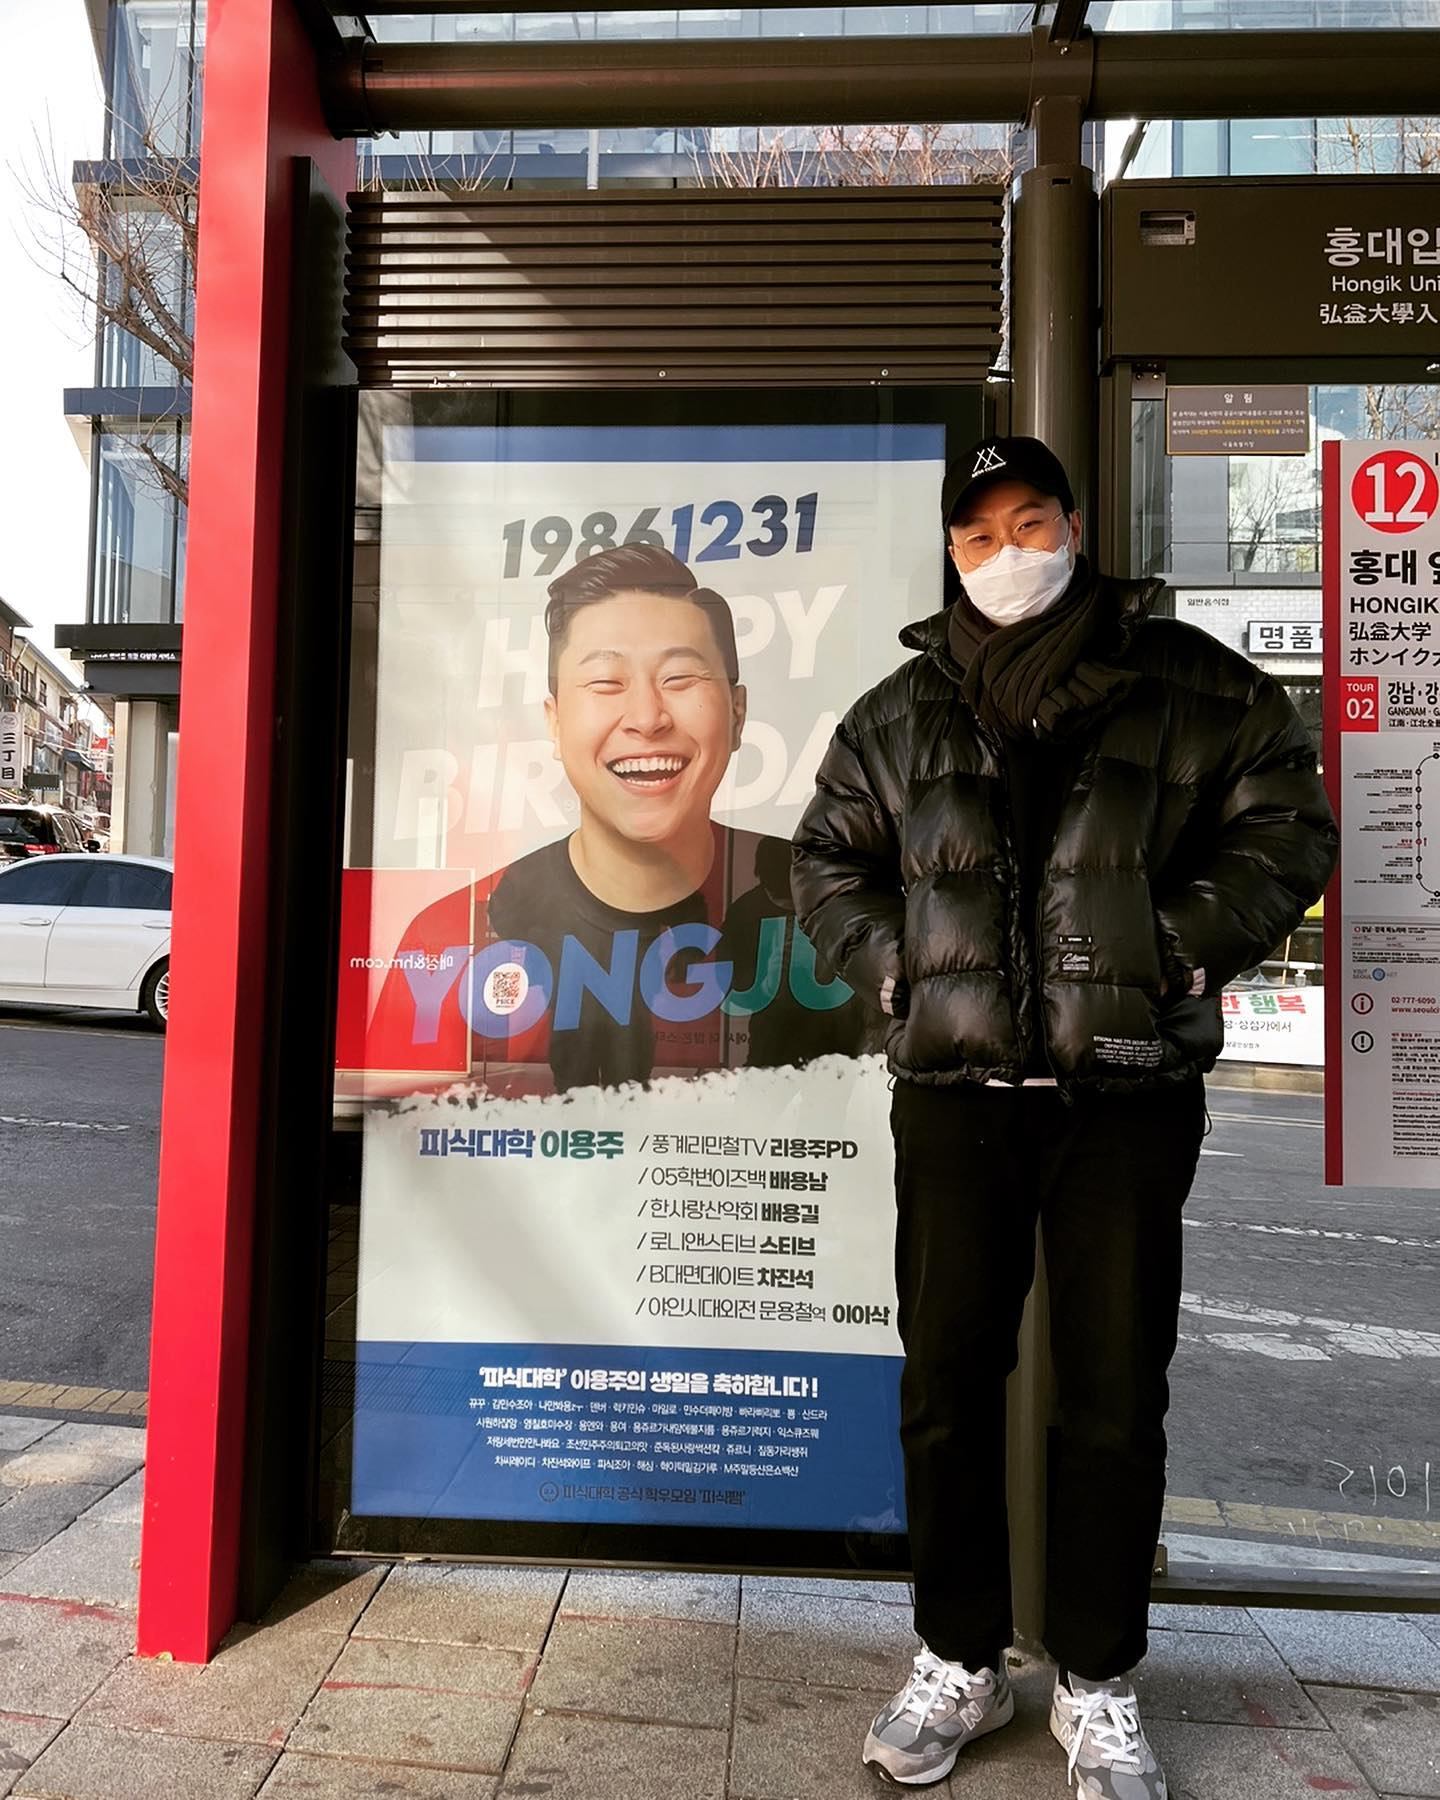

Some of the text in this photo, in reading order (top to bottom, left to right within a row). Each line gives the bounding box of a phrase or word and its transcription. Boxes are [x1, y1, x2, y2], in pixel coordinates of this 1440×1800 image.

[1331, 275, 1402, 295] Hongik
[1364, 461, 1429, 523] 12
[502, 491, 819, 579] 19861231
[1349, 550, 1417, 586] 홍대
[1349, 597, 1440, 614] HONGIK
[1349, 621, 1432, 641] 弘益大学
[1346, 682, 1375, 693] TOUR
[1346, 697, 1376, 721] 02
[1247, 993, 1307, 1015] 행복
[419, 1128, 625, 1159] 피식대학 이용주
[770, 1138, 859, 1159] 리용주PD
[769, 1171, 828, 1192] 배용남
[761, 1203, 820, 1225] 배용길
[759, 1235, 817, 1257] 스티브
[757, 1267, 815, 1290] 차진석
[570, 1368, 647, 1392] 이용주의
[649, 1371, 709, 1394] 생일을
